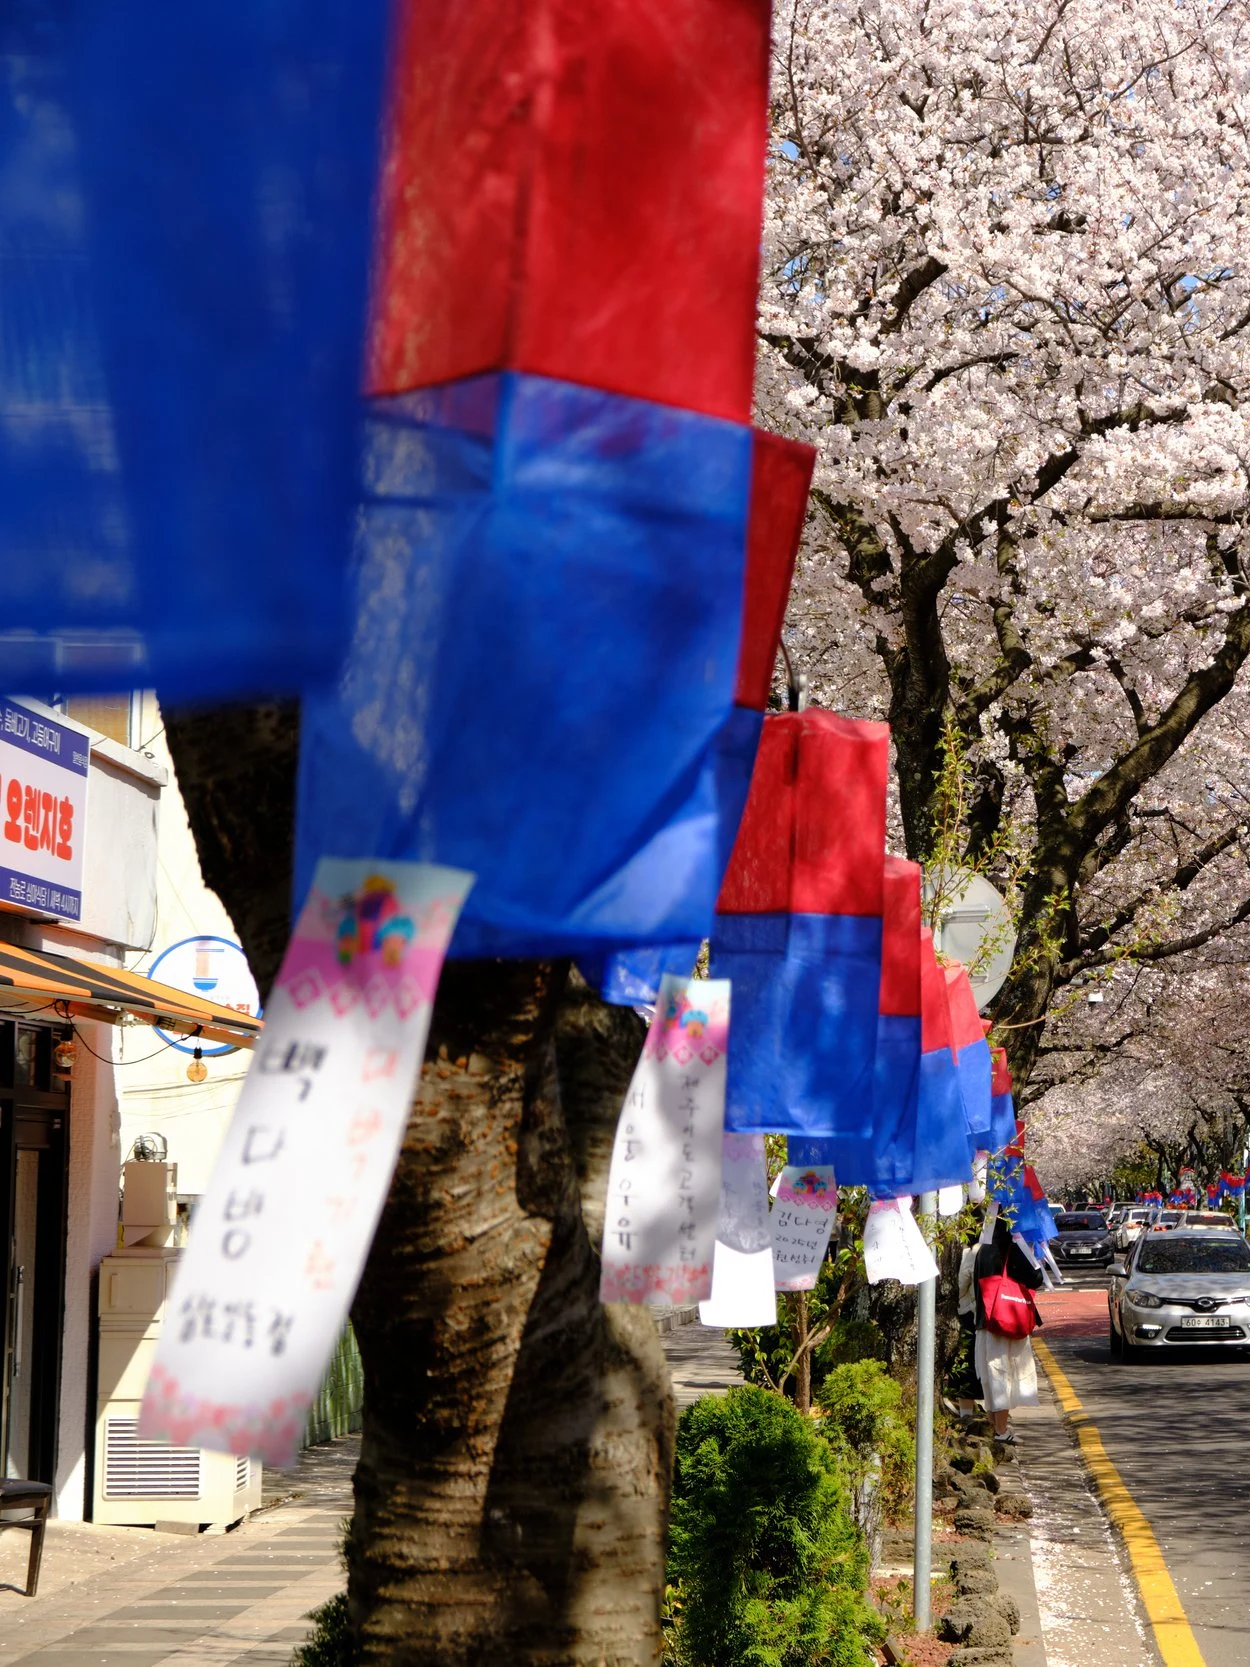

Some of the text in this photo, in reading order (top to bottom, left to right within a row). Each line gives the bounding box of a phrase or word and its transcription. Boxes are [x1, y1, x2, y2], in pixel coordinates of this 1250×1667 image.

[31, 721, 61, 755] 고등어구이
[4, 778, 74, 861] 오렌지호
[10, 877, 26, 900] 전농로
[777, 1209, 829, 1235] 김다영
[1205, 1318, 1226, 1327] 4143
